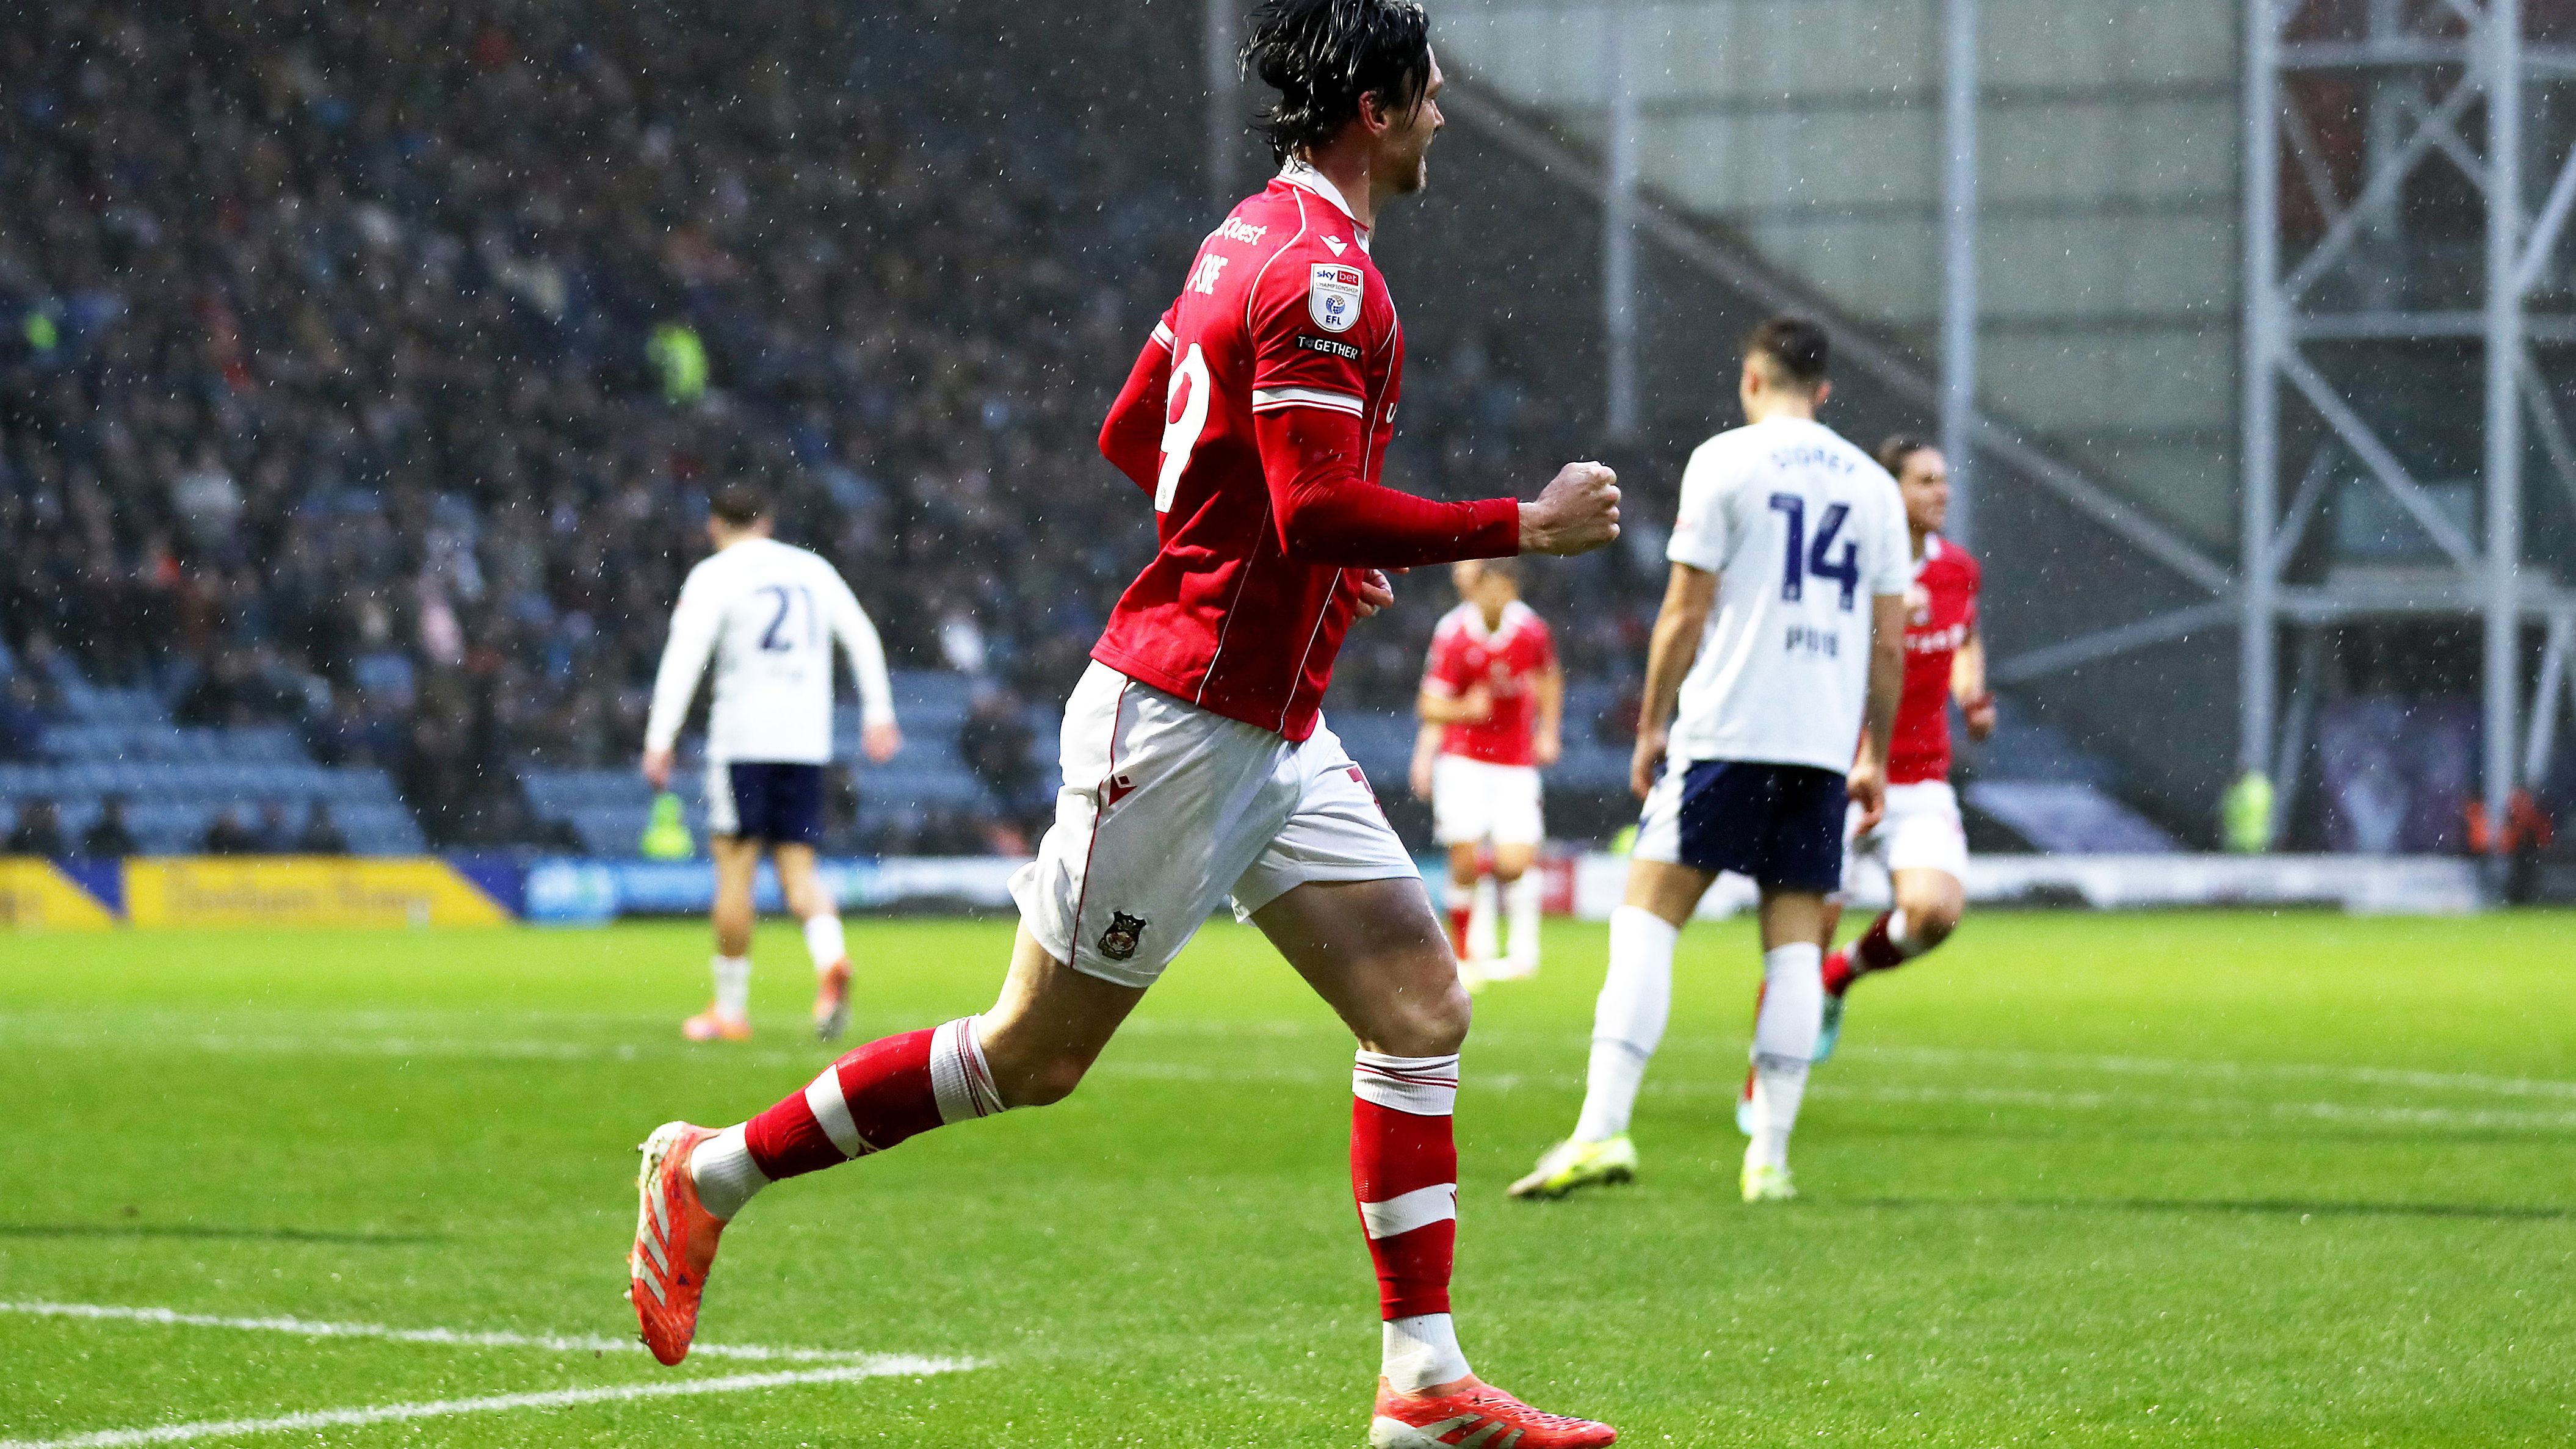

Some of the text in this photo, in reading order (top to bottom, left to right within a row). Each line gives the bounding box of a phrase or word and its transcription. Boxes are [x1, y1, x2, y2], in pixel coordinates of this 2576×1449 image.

[1315, 282, 1359, 293] CHAMPIONSHIP
[1317, 270, 1357, 284] sky bet
[1326, 315, 1341, 325] EFL
[1154, 336, 1210, 513] 9
[1770, 493, 1859, 611] 14
[754, 583, 817, 652] 21
